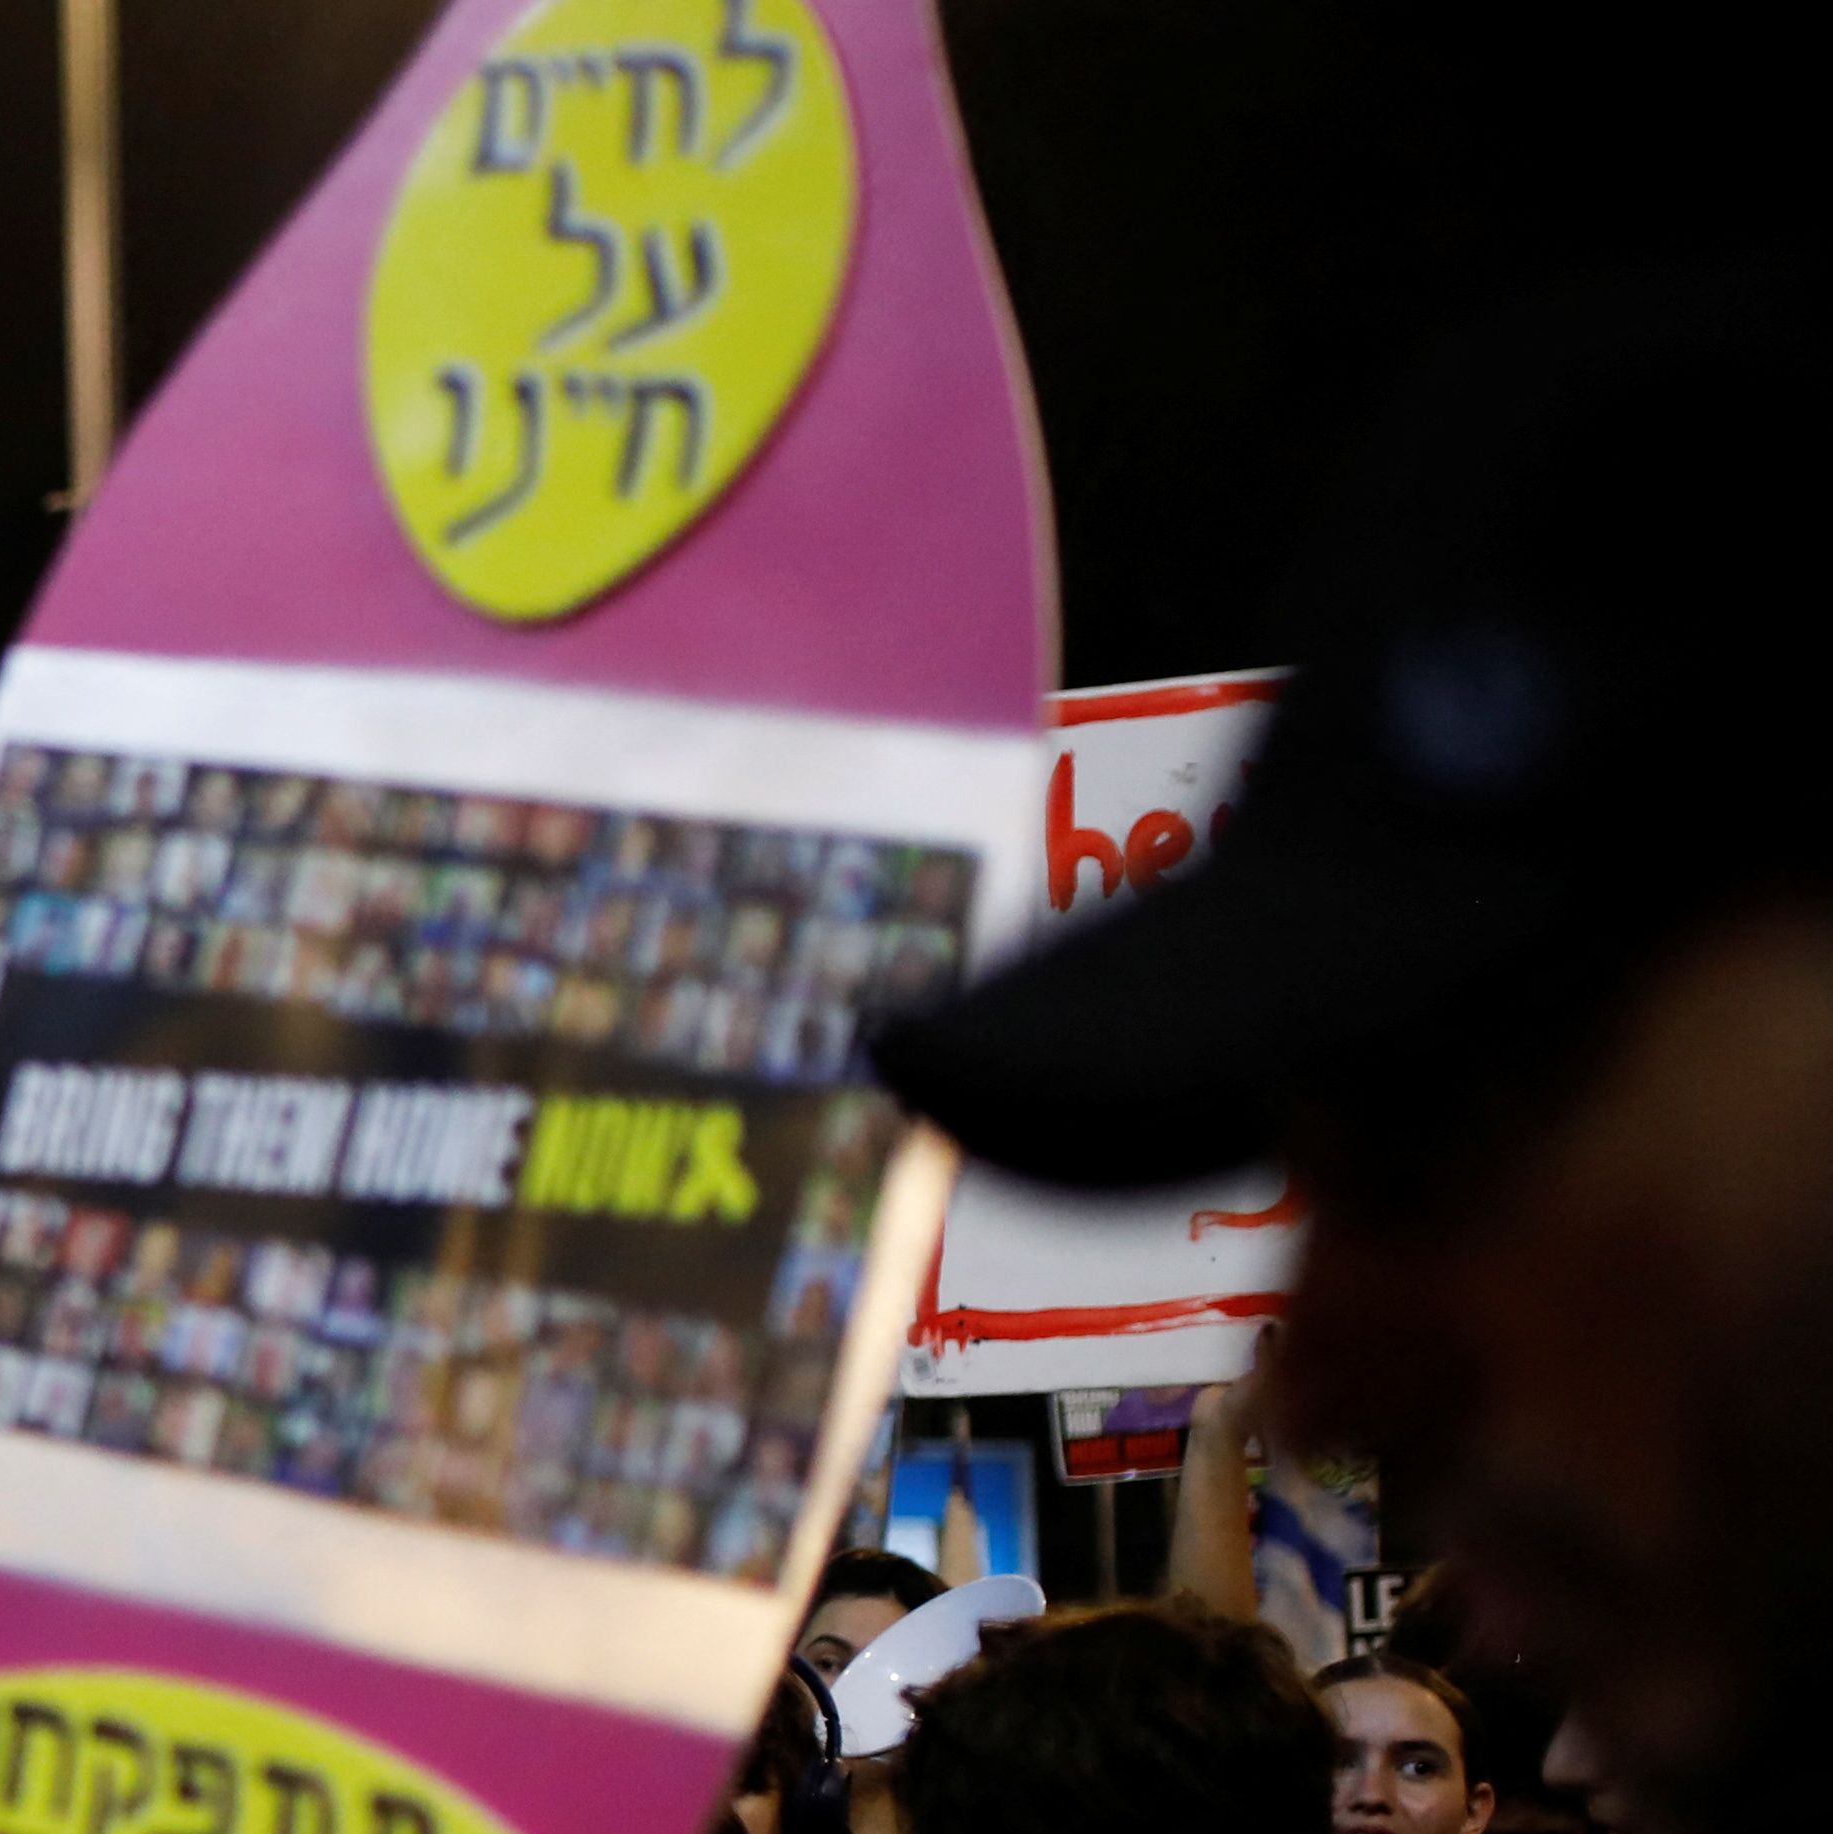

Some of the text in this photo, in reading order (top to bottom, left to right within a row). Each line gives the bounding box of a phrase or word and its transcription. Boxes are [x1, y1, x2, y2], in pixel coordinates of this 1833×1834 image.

[536, 160, 729, 355] על
[173, 1068, 352, 1194] THEM
[339, 1077, 534, 1210] HOME
